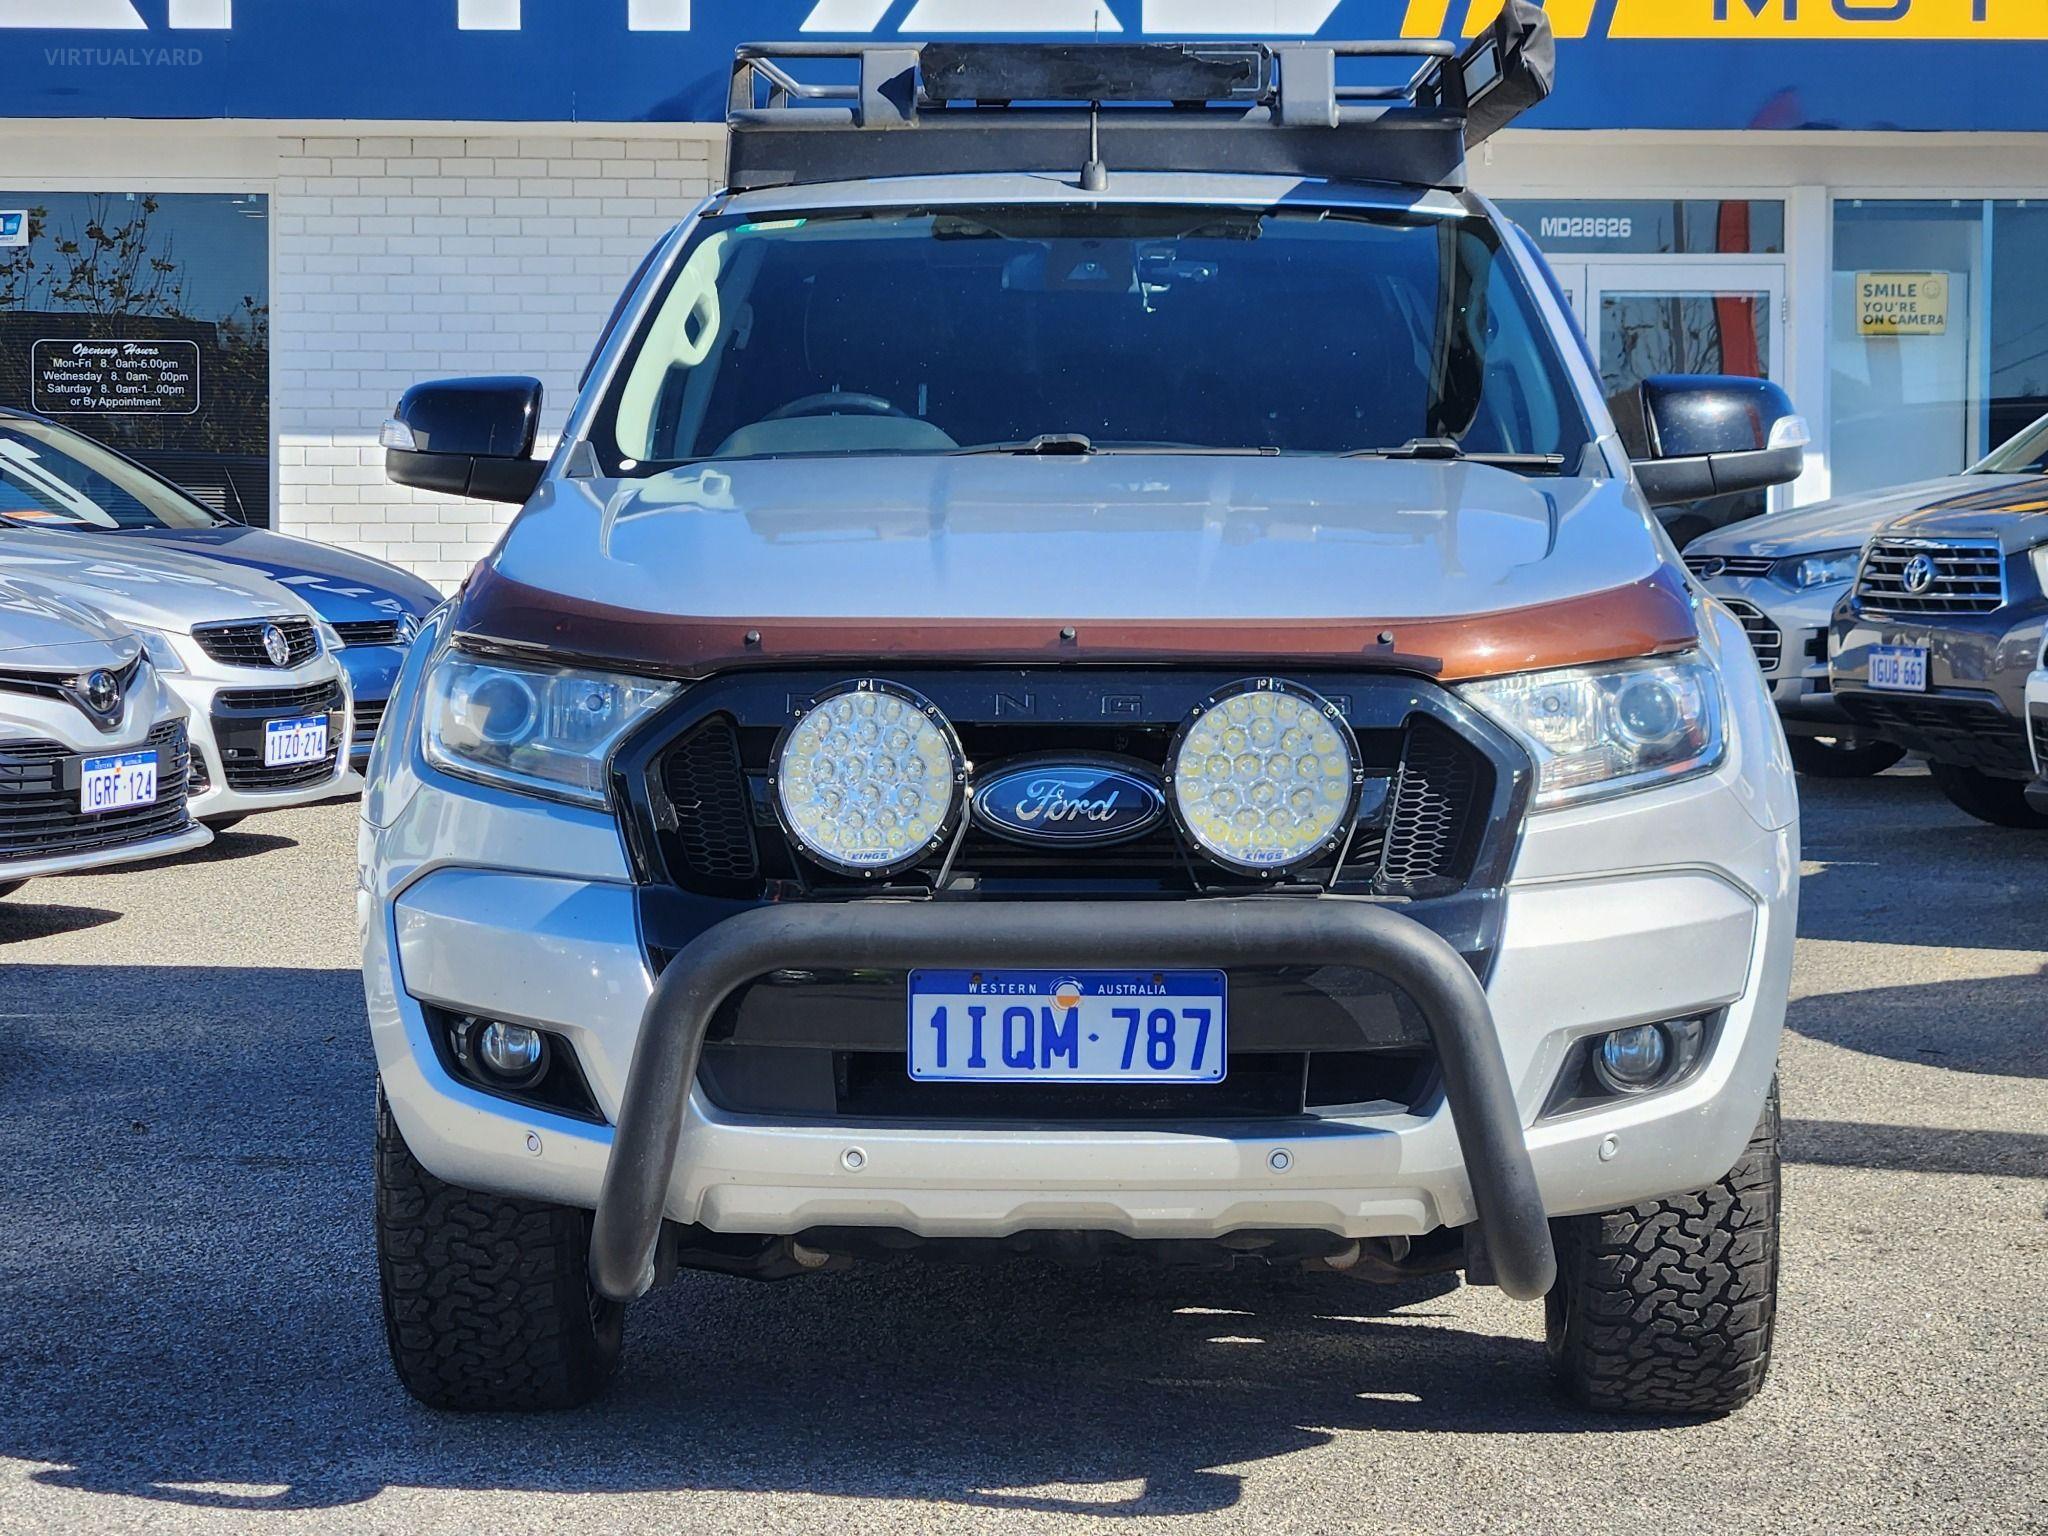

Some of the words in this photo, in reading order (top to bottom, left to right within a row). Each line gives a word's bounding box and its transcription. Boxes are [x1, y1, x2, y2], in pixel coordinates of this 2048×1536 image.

[1541, 217, 1632, 238] MD28626
[1863, 283, 1917, 298] SMILE
[1863, 302, 1917, 313] YOU'RE
[1863, 314, 1884, 325] ON
[1888, 314, 1944, 325] CAMERA
[72, 343, 118, 358] Opening
[122, 343, 159, 356] Hours
[53, 359, 92, 368] Mon-Fri
[43, 371, 102, 383] Wednesday
[47, 384, 92, 395] Saturday
[70, 398, 81, 406] or
[83, 397, 96, 408] By
[98, 397, 162, 408] Appointment
[1015, 779, 1120, 821] Ford
[851, 852, 888, 860] KINGS
[1246, 852, 1283, 861] KINGS
[968, 983, 1037, 994] WESTERN
[1098, 984, 1167, 995] AUSTRALIA
